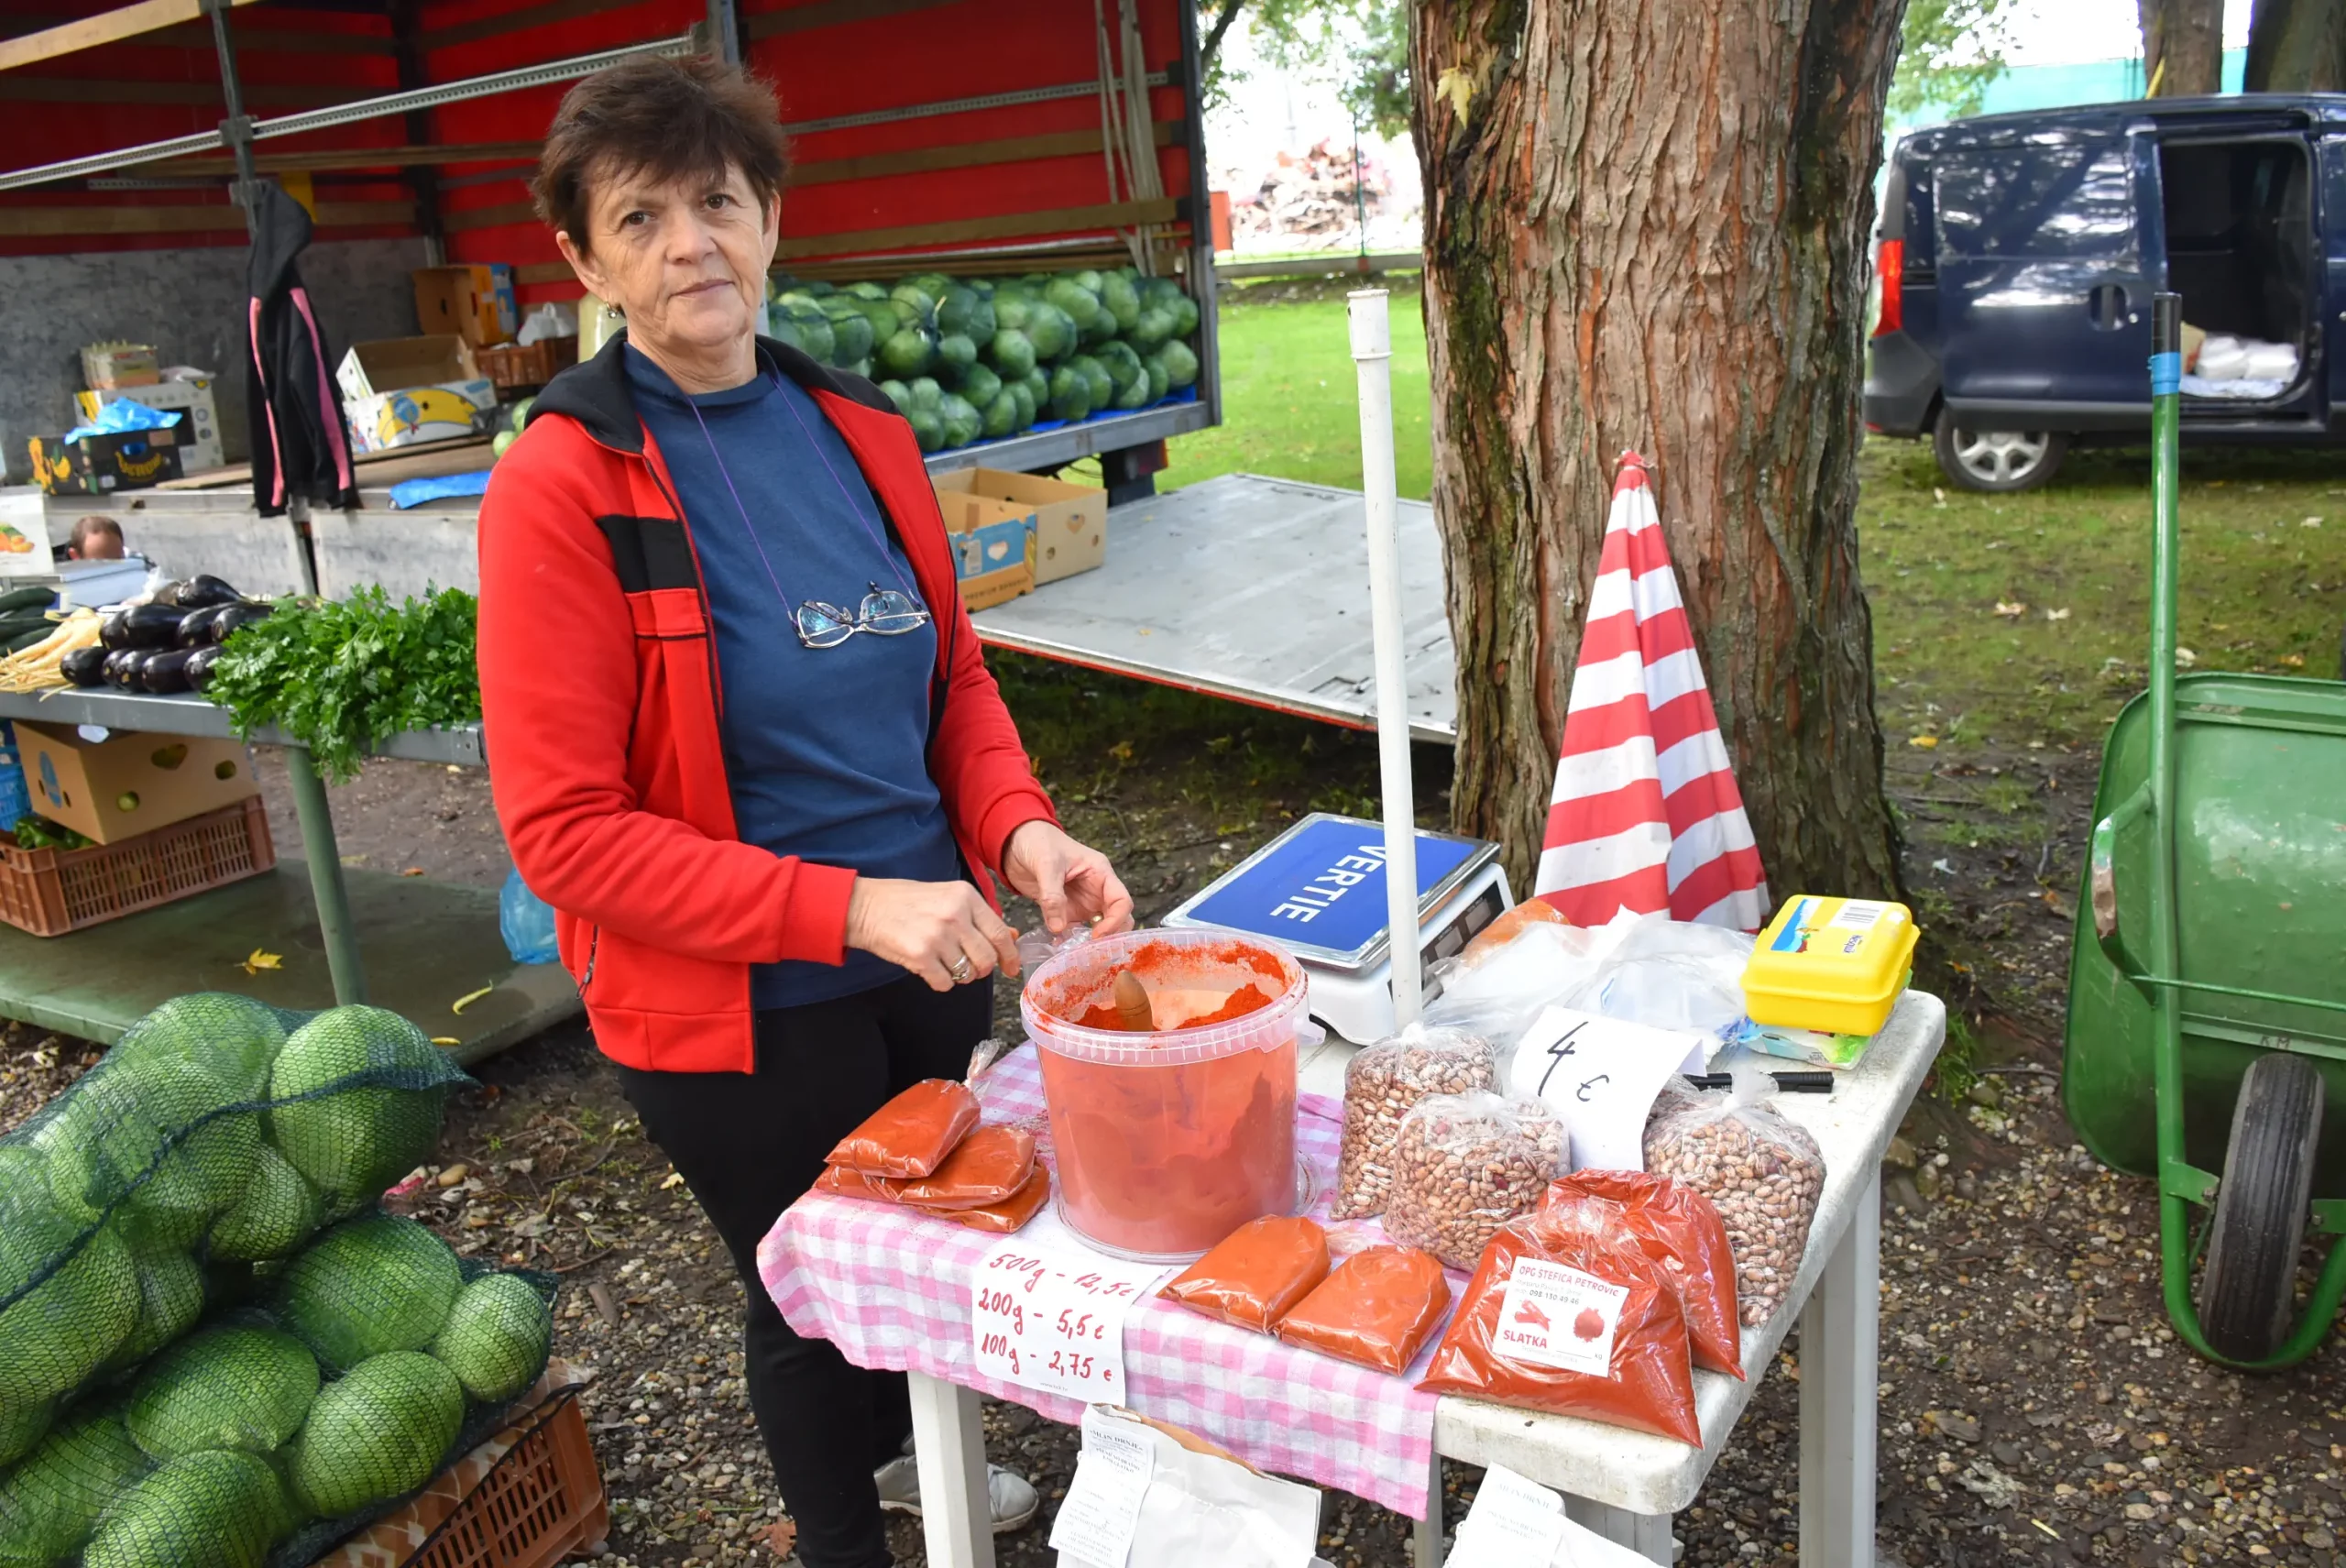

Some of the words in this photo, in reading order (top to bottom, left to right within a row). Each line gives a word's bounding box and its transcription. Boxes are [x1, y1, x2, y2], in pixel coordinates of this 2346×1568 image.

[1538, 1021, 1589, 1097] 4
[990, 1254, 1046, 1293] 500g
[1519, 1266, 1536, 1277] OPG
[978, 1288, 1024, 1335] 200g
[981, 1332, 1020, 1375] 100g
[1048, 1351, 1094, 1379] 2,75
[1503, 1330, 1548, 1350] SLATKA
[1595, 1353, 1603, 1361] kg
